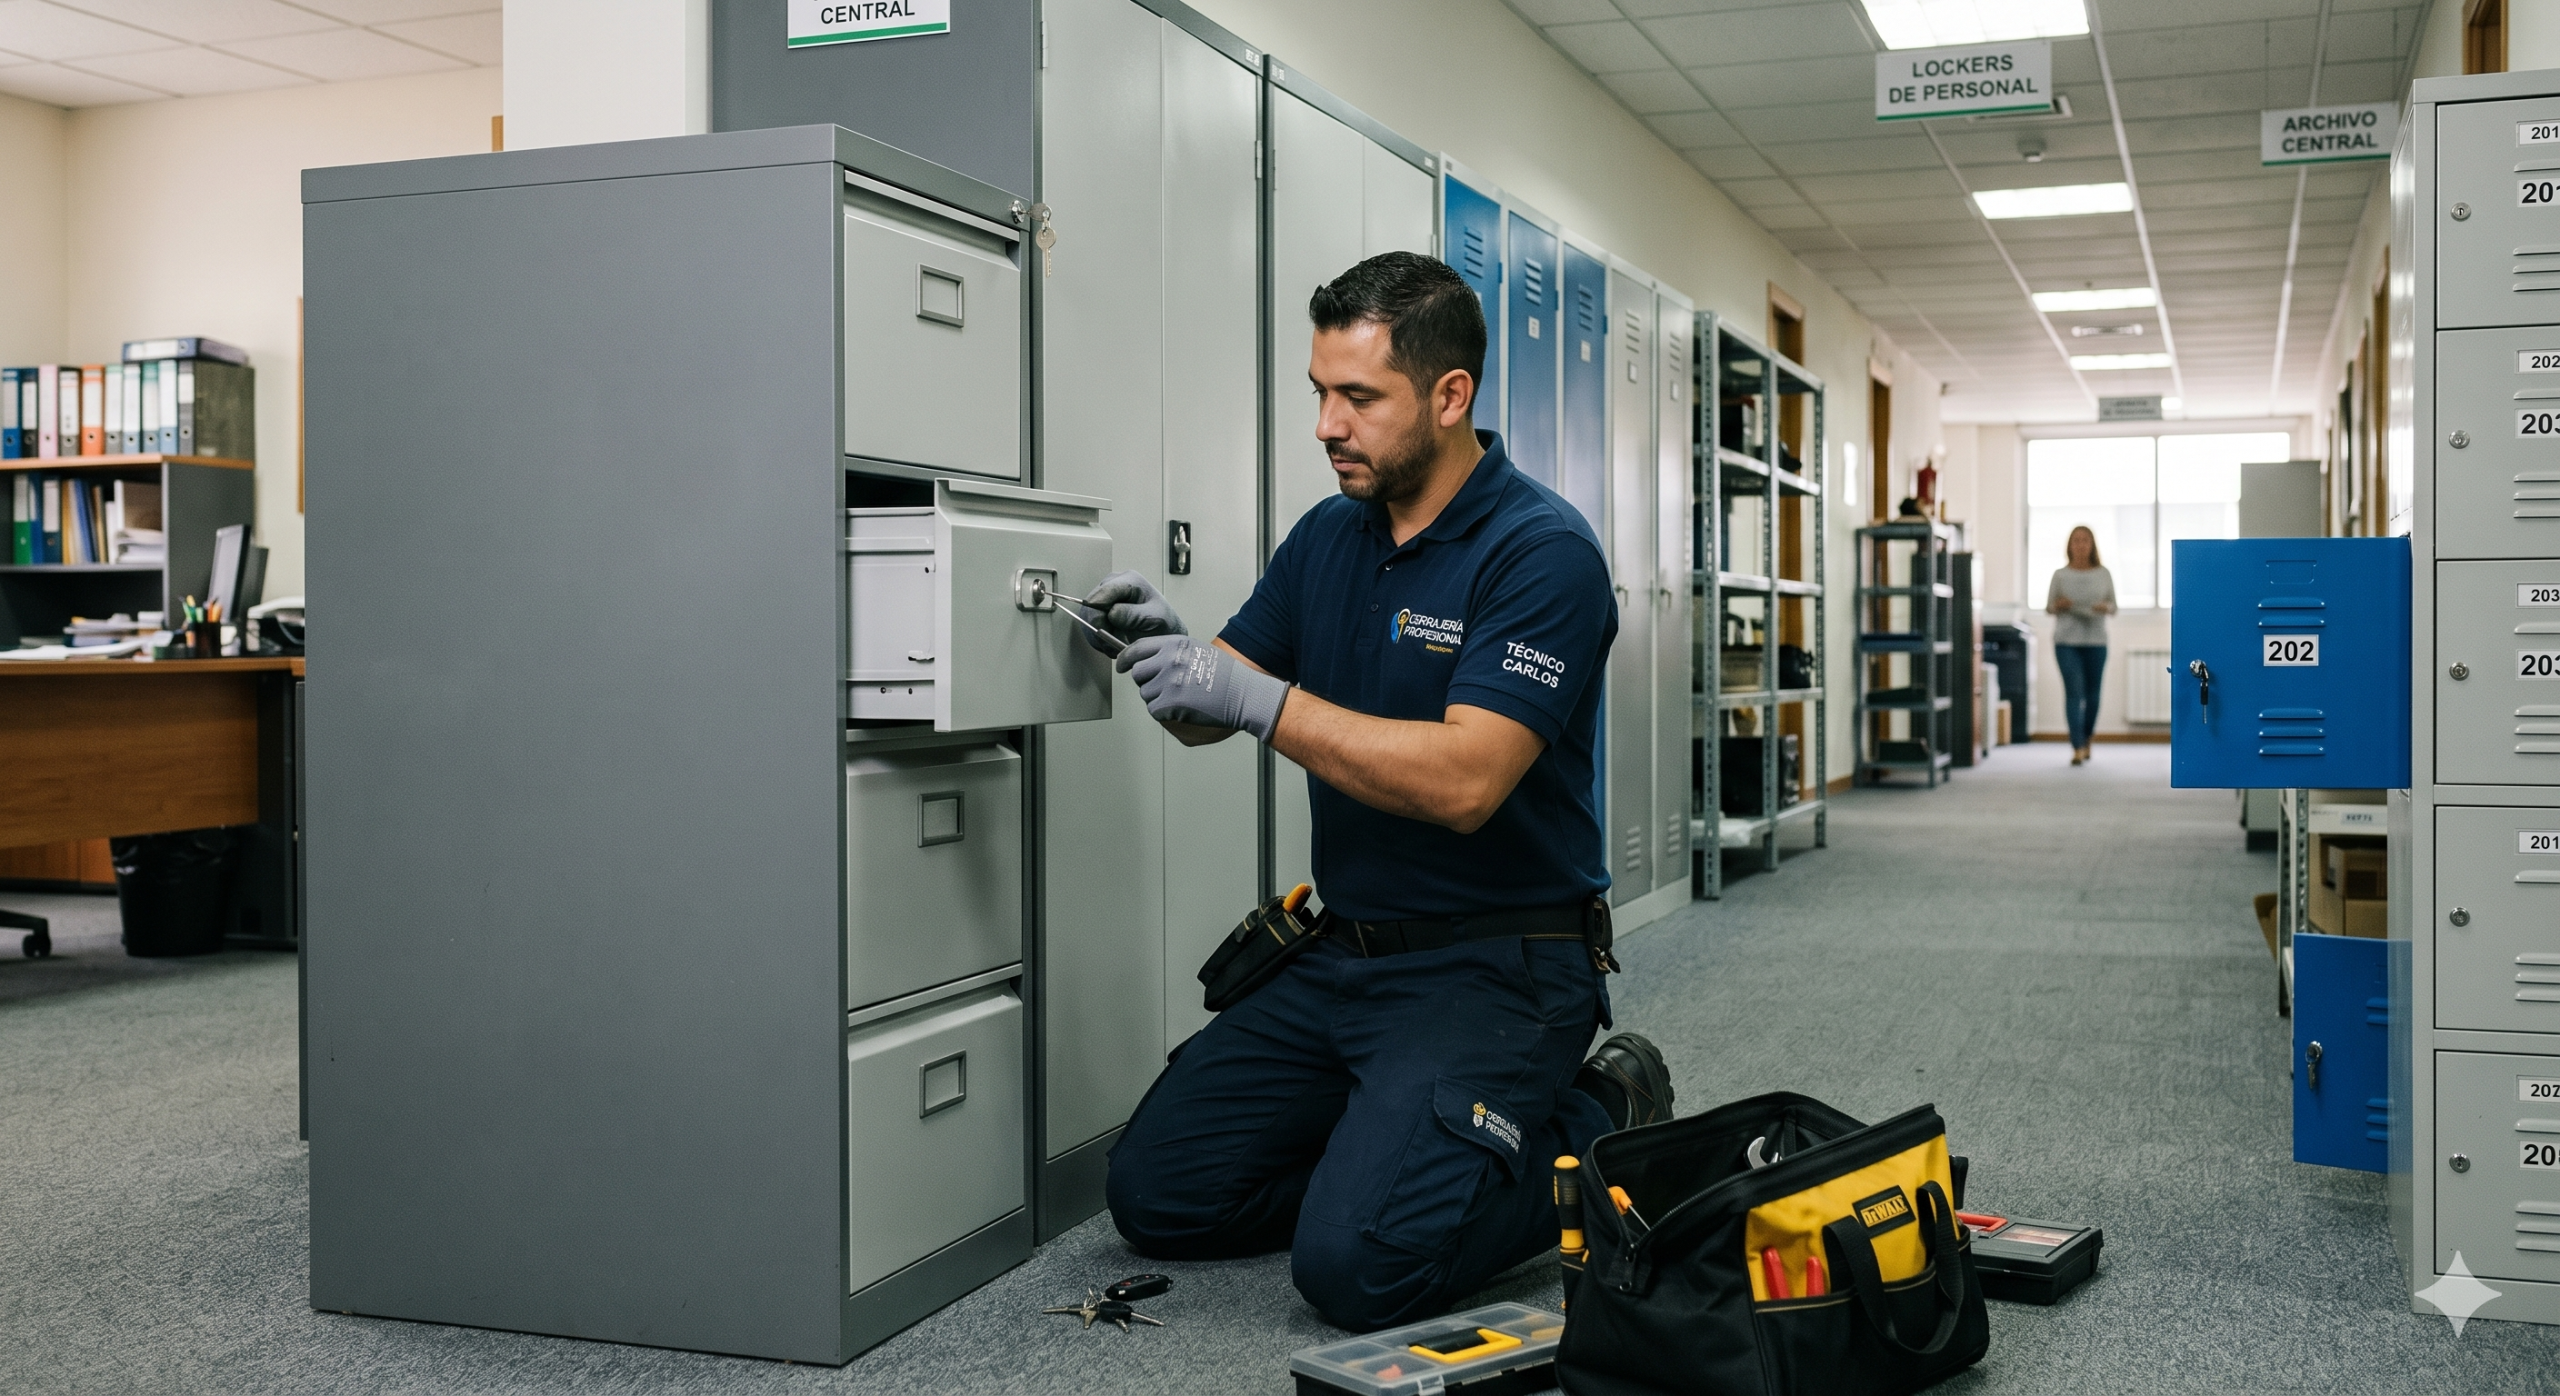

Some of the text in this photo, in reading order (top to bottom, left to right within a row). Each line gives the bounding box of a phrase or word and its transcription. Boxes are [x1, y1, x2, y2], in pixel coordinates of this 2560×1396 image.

[821, 0, 915, 24] CENTRAL
[1912, 54, 2013, 78] LOCKERS
[1889, 78, 2038, 103] DE PERSONAL
[2283, 110, 2377, 132] ARCHIVO
[2282, 132, 2378, 153] CENTRAL
[2522, 181, 2560, 204] 20
[1506, 641, 1565, 674] TÉCNICO
[2268, 640, 2314, 661] 202
[1502, 658, 1559, 688] CARLOS
[2523, 1143, 2560, 1166] 20
